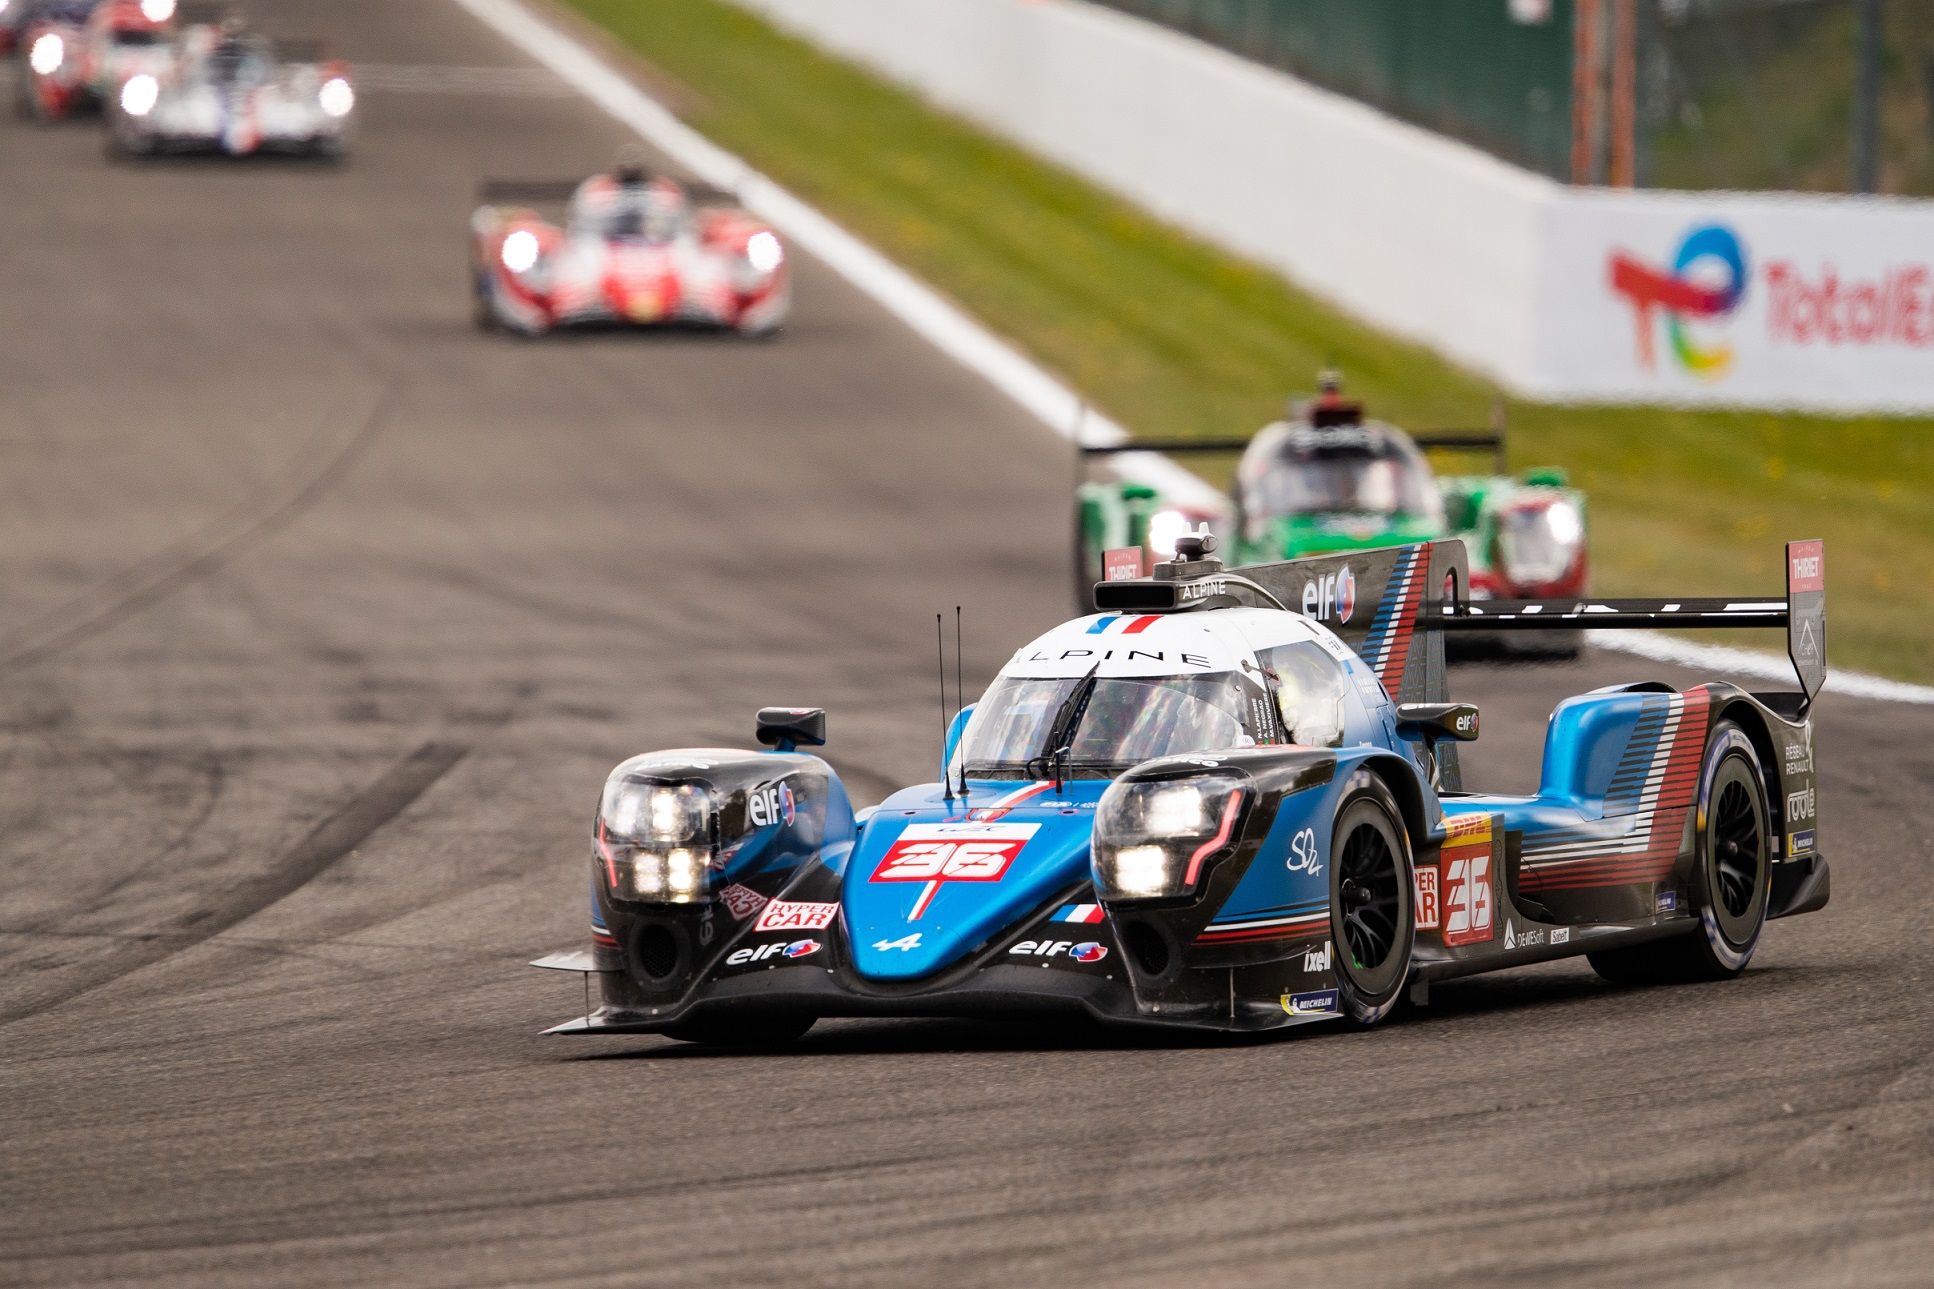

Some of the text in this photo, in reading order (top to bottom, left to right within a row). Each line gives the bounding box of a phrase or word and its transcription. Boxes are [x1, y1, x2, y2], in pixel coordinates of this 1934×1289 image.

[1182, 580, 1226, 600] ALPINE
[1302, 574, 1335, 621] elf
[1012, 650, 1211, 668] LPINE
[1456, 715, 1471, 731] elf
[1786, 759, 1808, 775] RENAULT
[750, 788, 781, 826] elf
[879, 842, 1016, 877] 36
[1446, 856, 1490, 935] 36
[770, 903, 834, 914] HYPER
[763, 913, 824, 927] CAR
[726, 942, 787, 966] elf
[1009, 940, 1073, 956] elf
[1300, 997, 1333, 1009] MICHELIN
